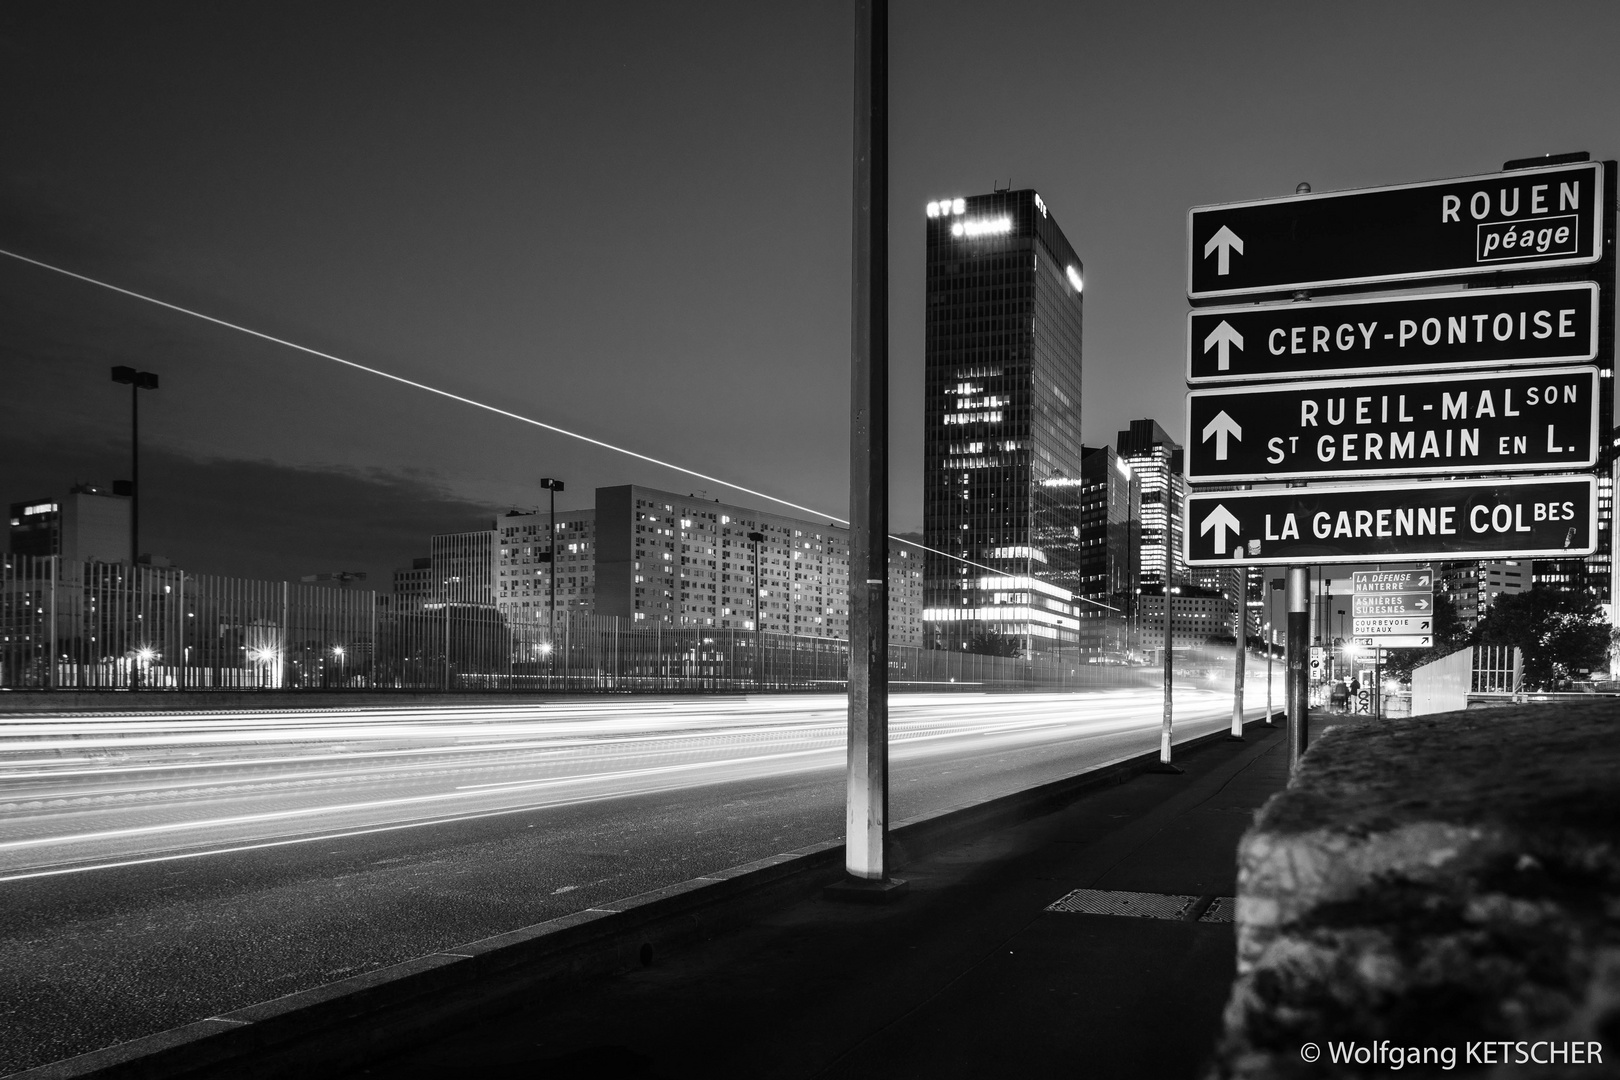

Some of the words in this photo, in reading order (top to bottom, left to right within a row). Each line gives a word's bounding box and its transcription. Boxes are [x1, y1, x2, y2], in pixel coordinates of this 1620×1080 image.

[1443, 181, 1579, 223] ROUEN
[1483, 225, 1570, 257] péage
[1268, 308, 1576, 356] CERGY-PONTOISE
[1316, 428, 1480, 463] GERMAIN
[1498, 435, 1527, 455] EN
[1547, 424, 1576, 453] L.
[1265, 512, 1300, 541] LA
[1312, 506, 1457, 539] GARENNE
[1356, 575, 1367, 583] LA
[1371, 573, 1412, 583] DÉFENSE
[1356, 582, 1404, 591] NANTERRE
[1356, 596, 1403, 605] ASNIÈRES
[1356, 605, 1406, 614] SURESNES
